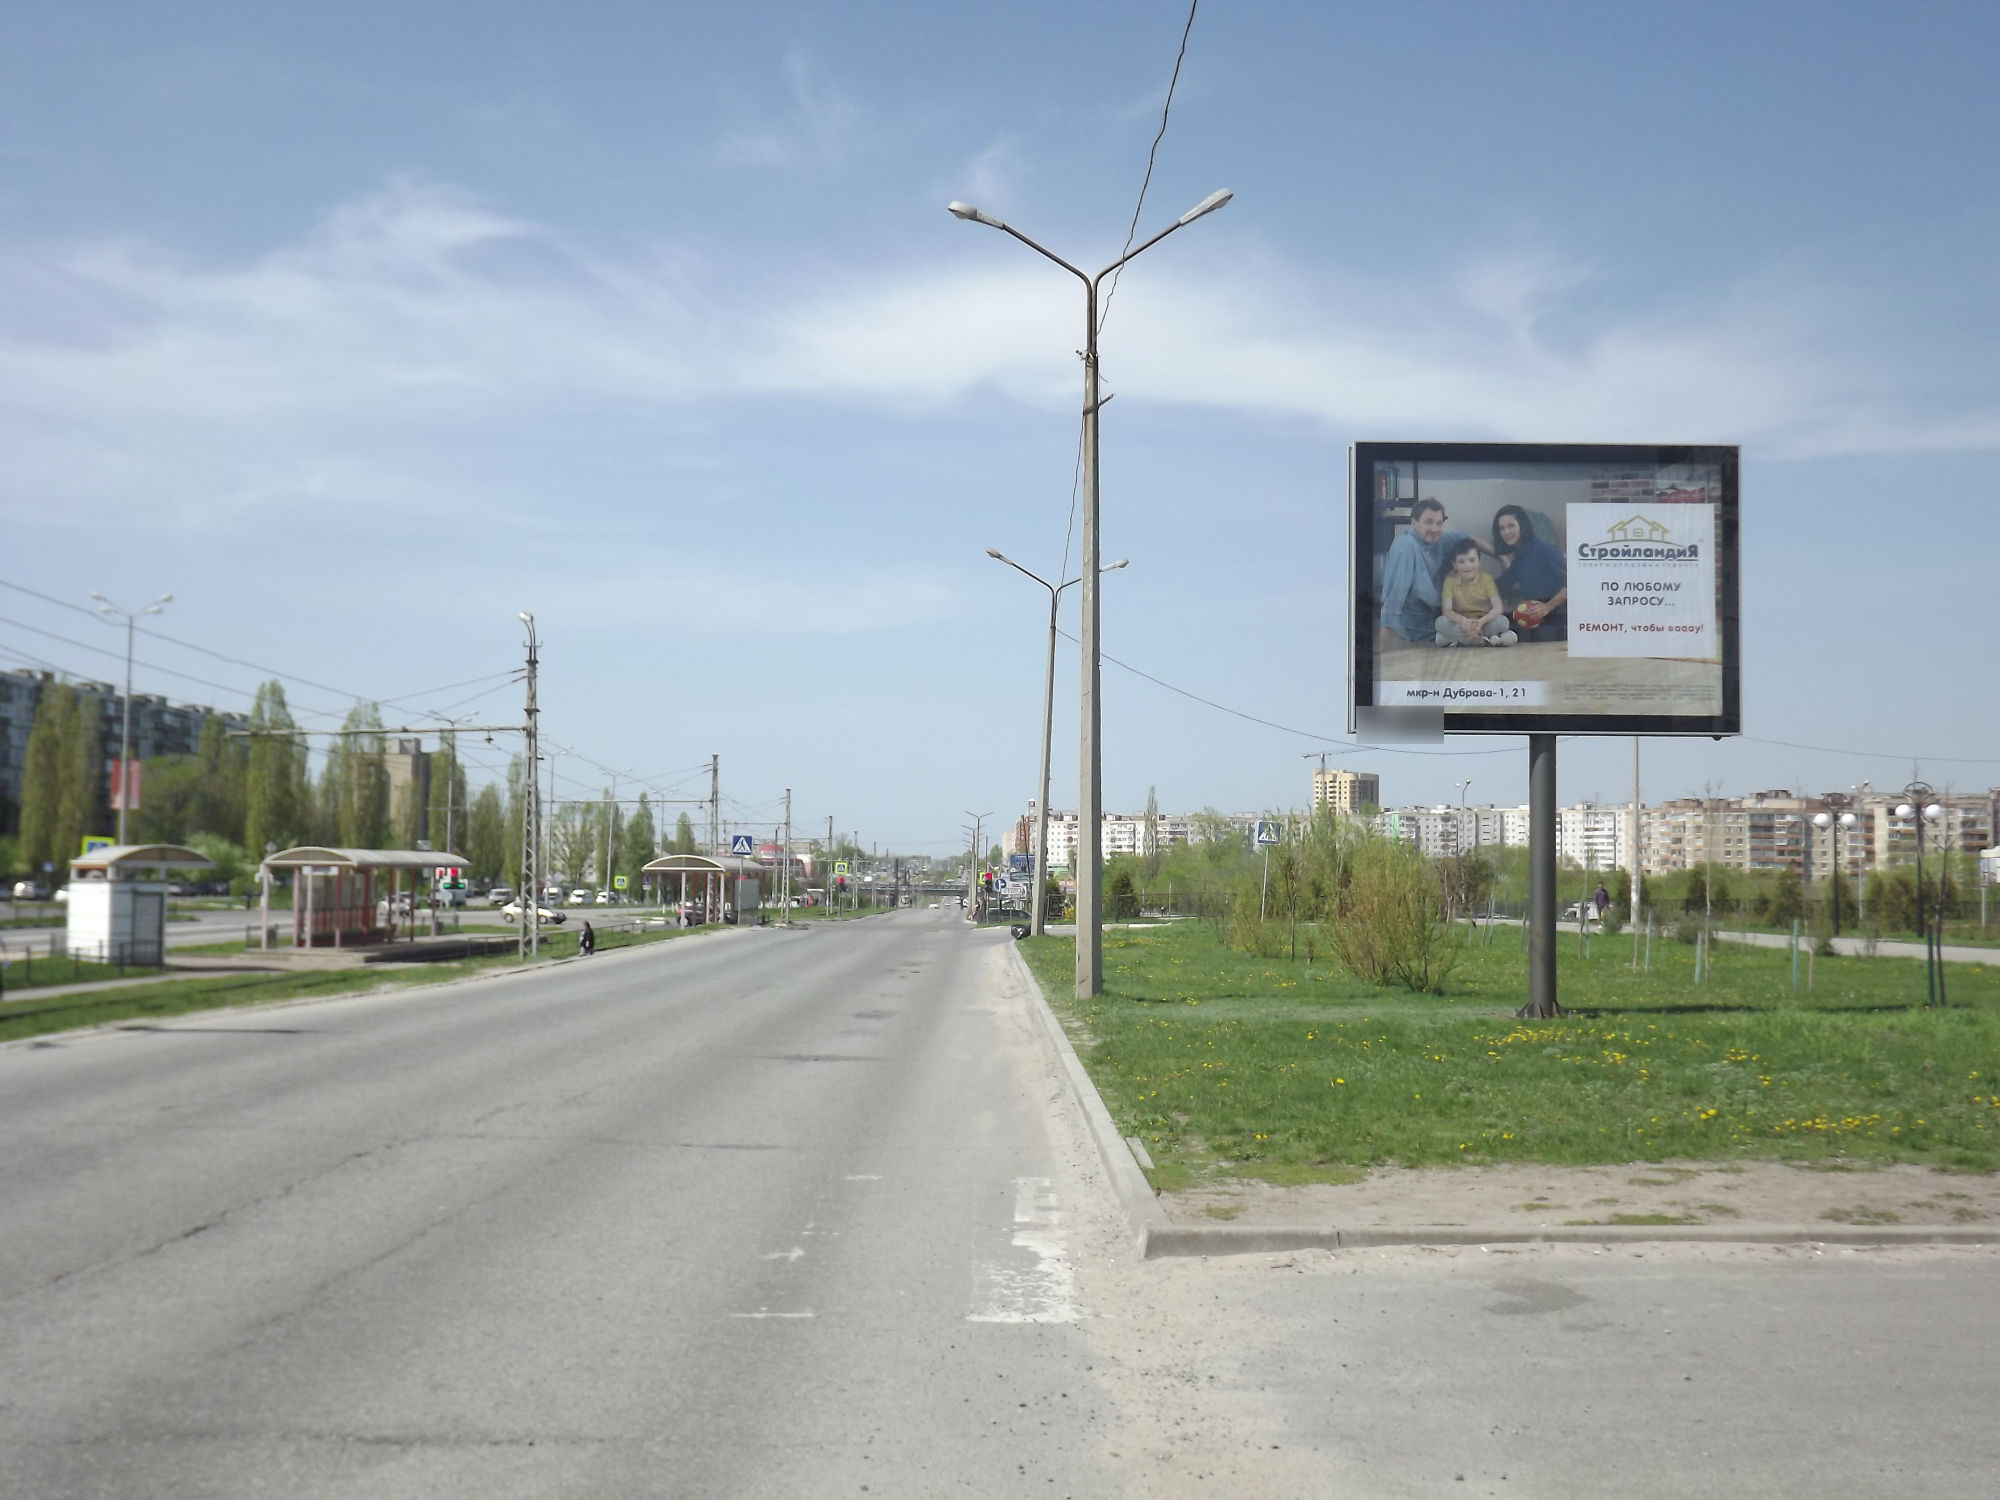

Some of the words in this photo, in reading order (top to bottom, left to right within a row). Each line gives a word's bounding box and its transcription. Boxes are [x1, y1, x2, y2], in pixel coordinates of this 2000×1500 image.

[1601, 582, 1619, 591] ПО
[1624, 582, 1681, 591] ЛЮБОМУ
[1579, 623, 1627, 633] РЕМОНТ,
[1631, 624, 1664, 632] чтобы
[1406, 689, 1440, 699] мкр-н
